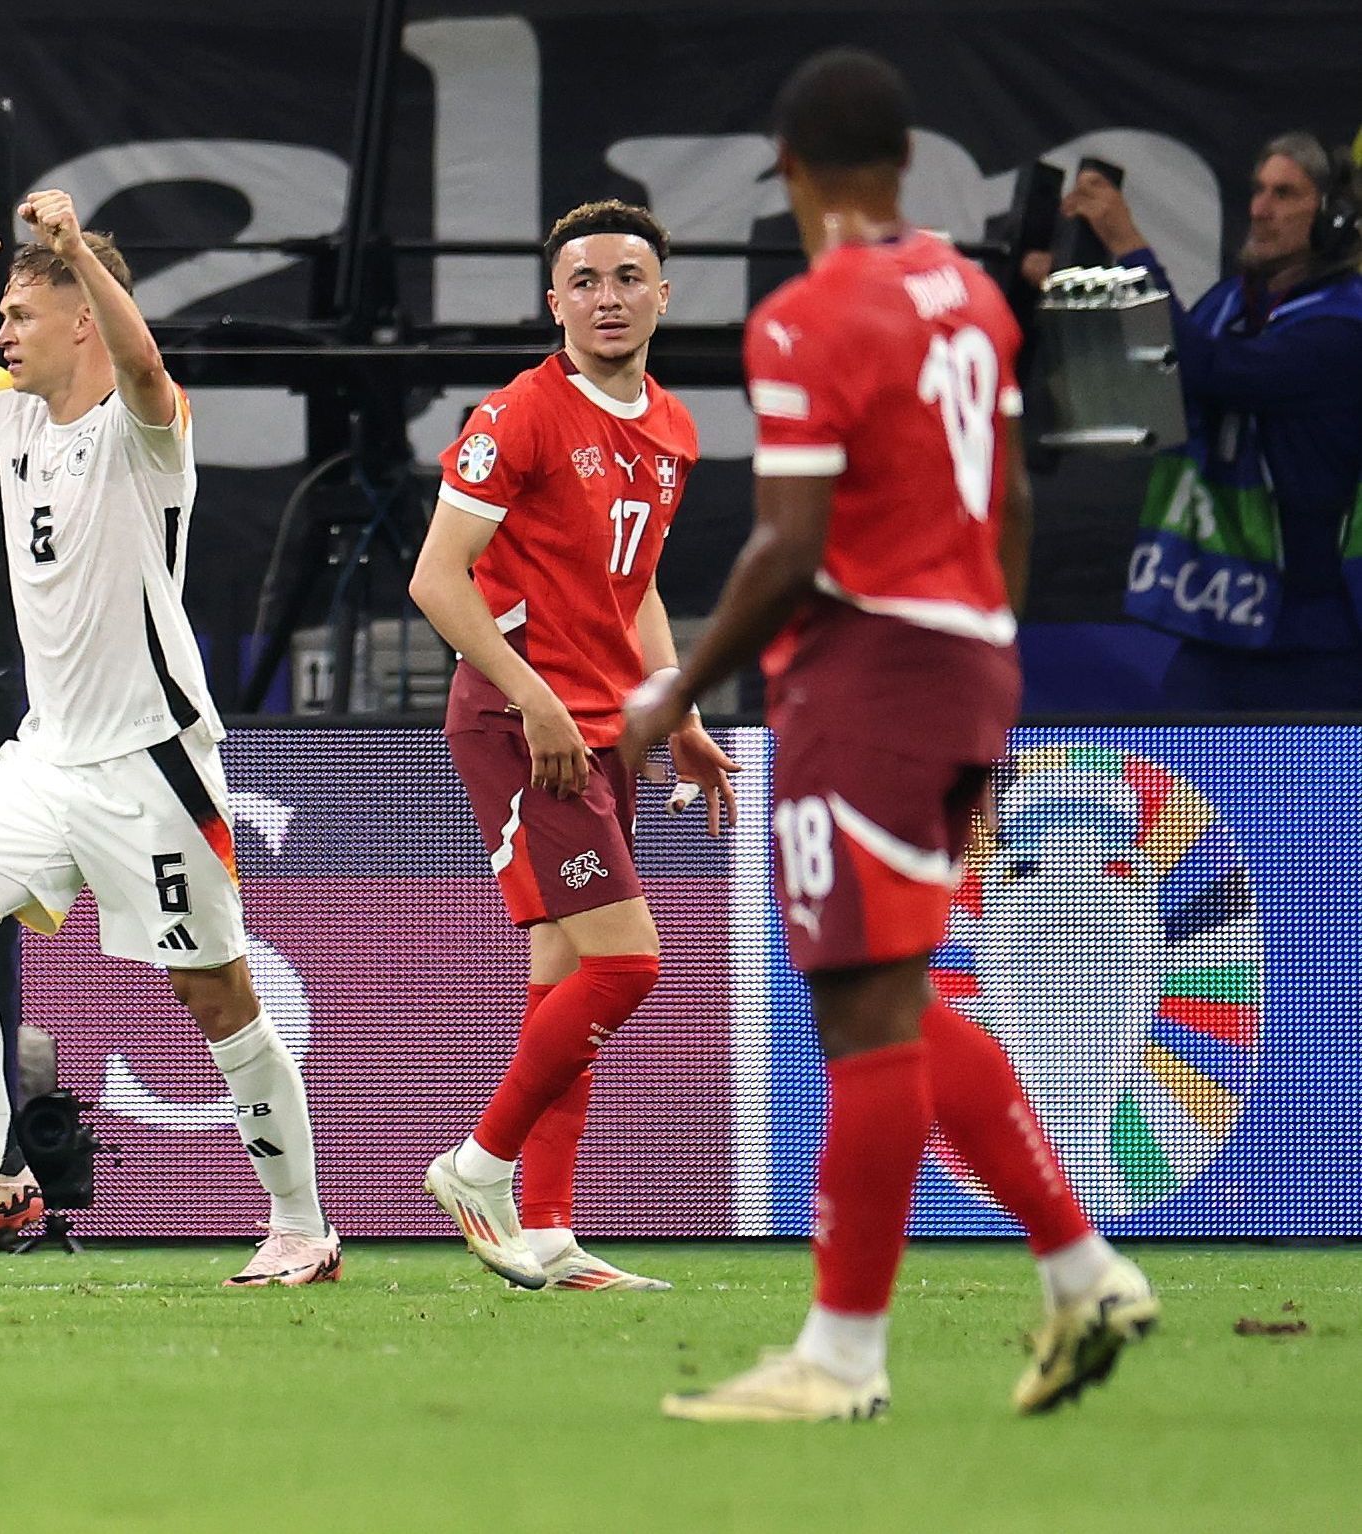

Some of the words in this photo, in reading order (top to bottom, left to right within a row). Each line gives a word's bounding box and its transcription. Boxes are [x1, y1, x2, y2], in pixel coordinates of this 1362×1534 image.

[30, 504, 58, 566] 6
[609, 497, 651, 576] 17
[773, 794, 835, 900] 18
[151, 851, 193, 916] 6
